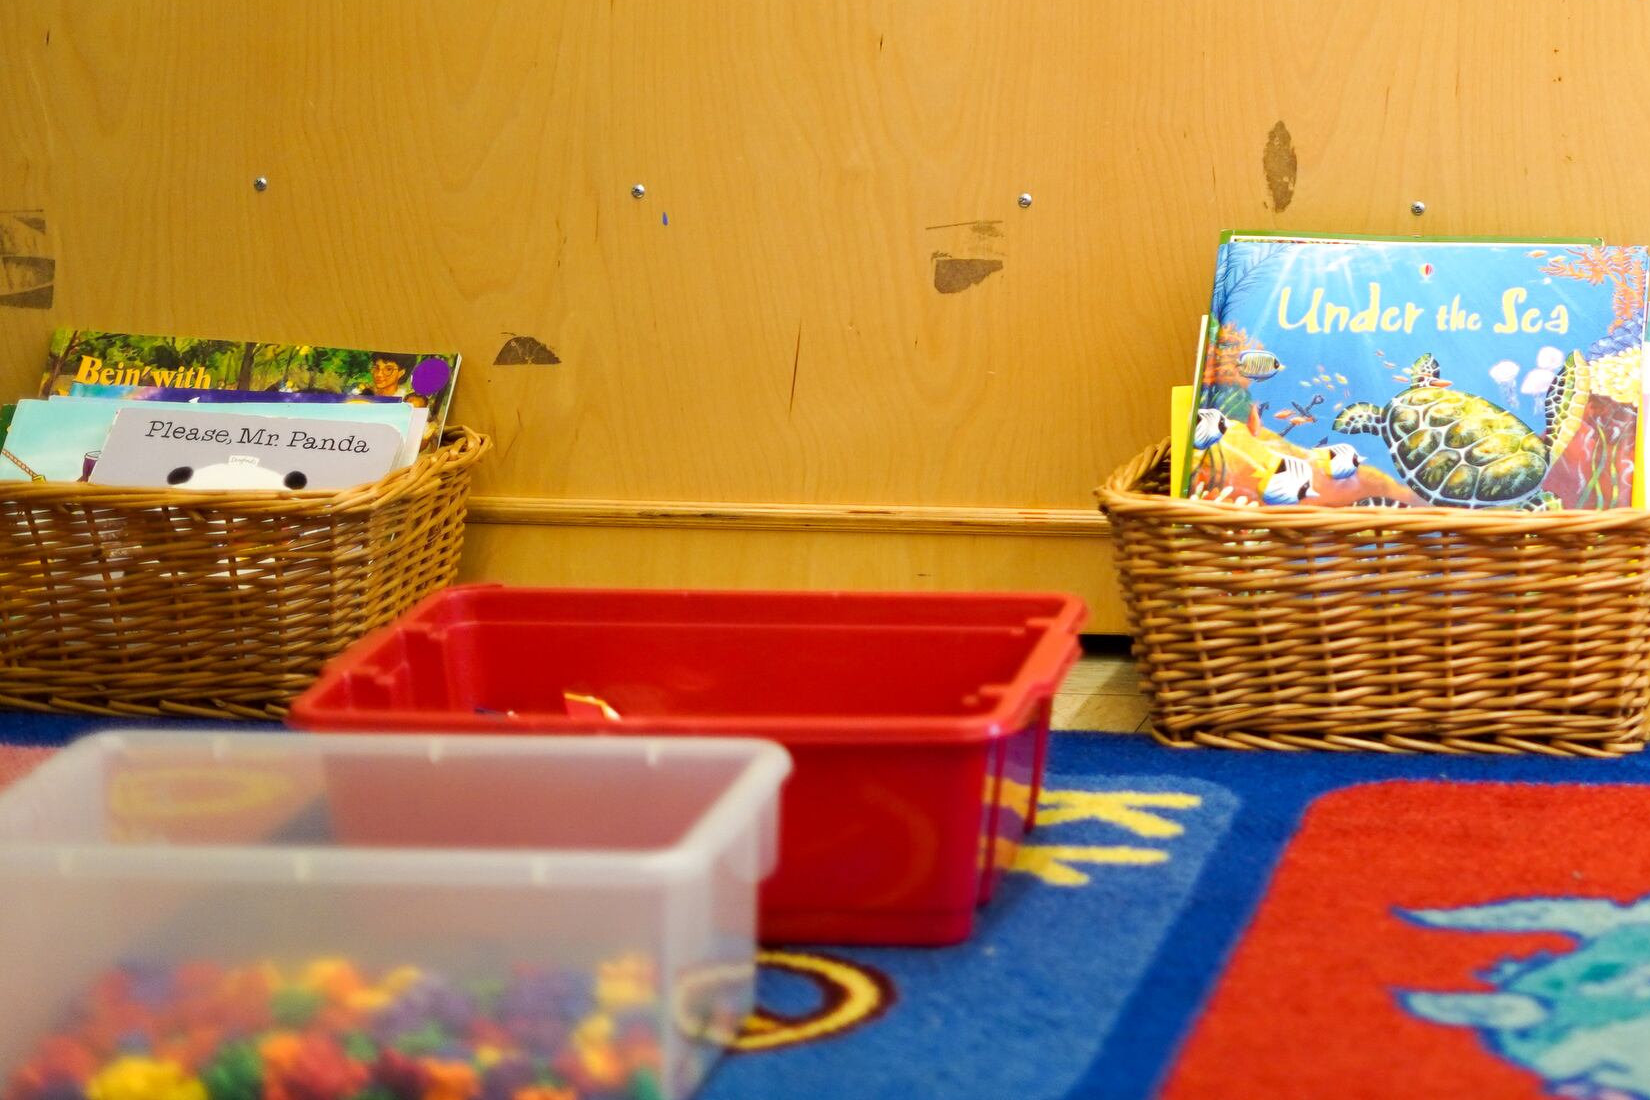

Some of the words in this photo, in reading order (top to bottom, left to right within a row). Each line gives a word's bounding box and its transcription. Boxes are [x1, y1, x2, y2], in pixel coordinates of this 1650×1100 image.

[1277, 283, 1424, 334] Under
[1435, 294, 1482, 331] the
[1494, 286, 1570, 335] Sea
[74, 354, 152, 387] Bein'
[152, 366, 212, 390] with
[144, 419, 234, 447] Please,
[235, 427, 280, 447] Mr.
[286, 430, 371, 455] Panda
